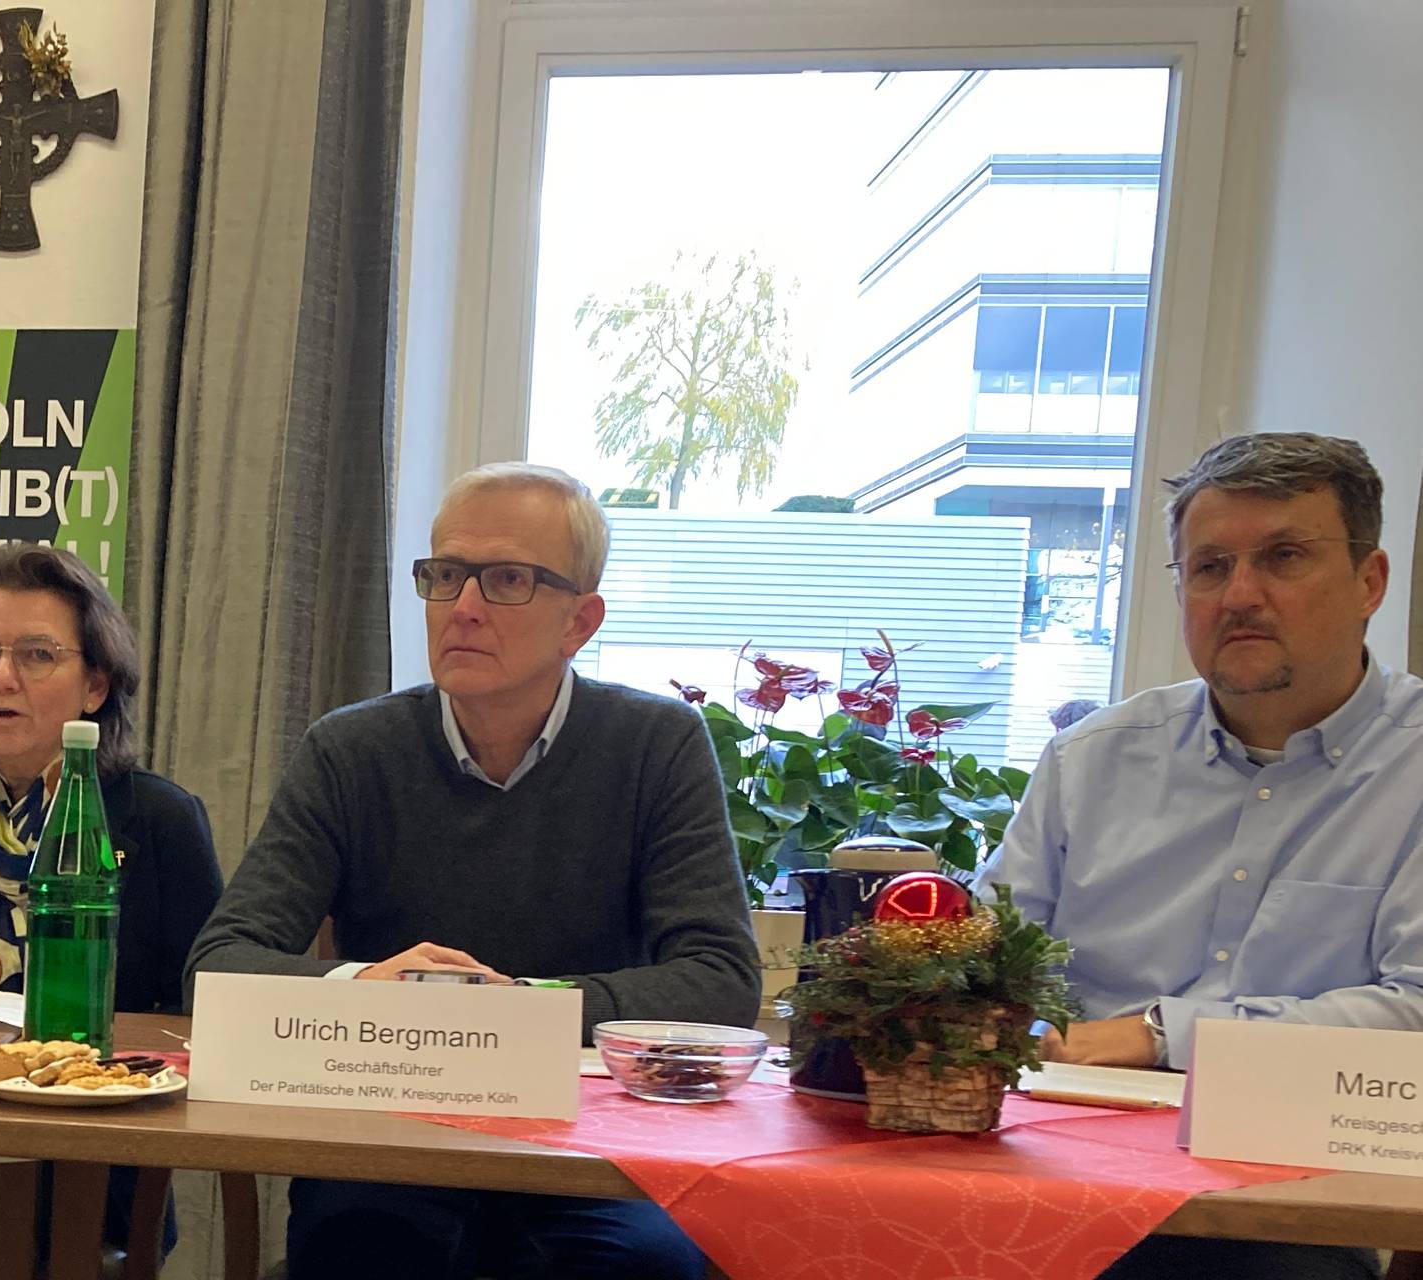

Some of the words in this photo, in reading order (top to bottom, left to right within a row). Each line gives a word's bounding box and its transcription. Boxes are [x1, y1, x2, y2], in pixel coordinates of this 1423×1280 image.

[274, 1017, 348, 1042] Ulrich
[359, 1021, 498, 1051] Bergmann
[324, 1058, 443, 1077] Geschäftsführer
[250, 1079, 274, 1092] Der
[278, 1081, 354, 1097] Paritätische
[402, 1087, 483, 1105] Kreisgruppe
[487, 1091, 518, 1104] Köln
[1336, 1070, 1417, 1100] Marc
[1331, 1113, 1423, 1135] Kreisgesc
[1328, 1141, 1366, 1156] DRK
[1370, 1144, 1423, 1160] Kreisv
